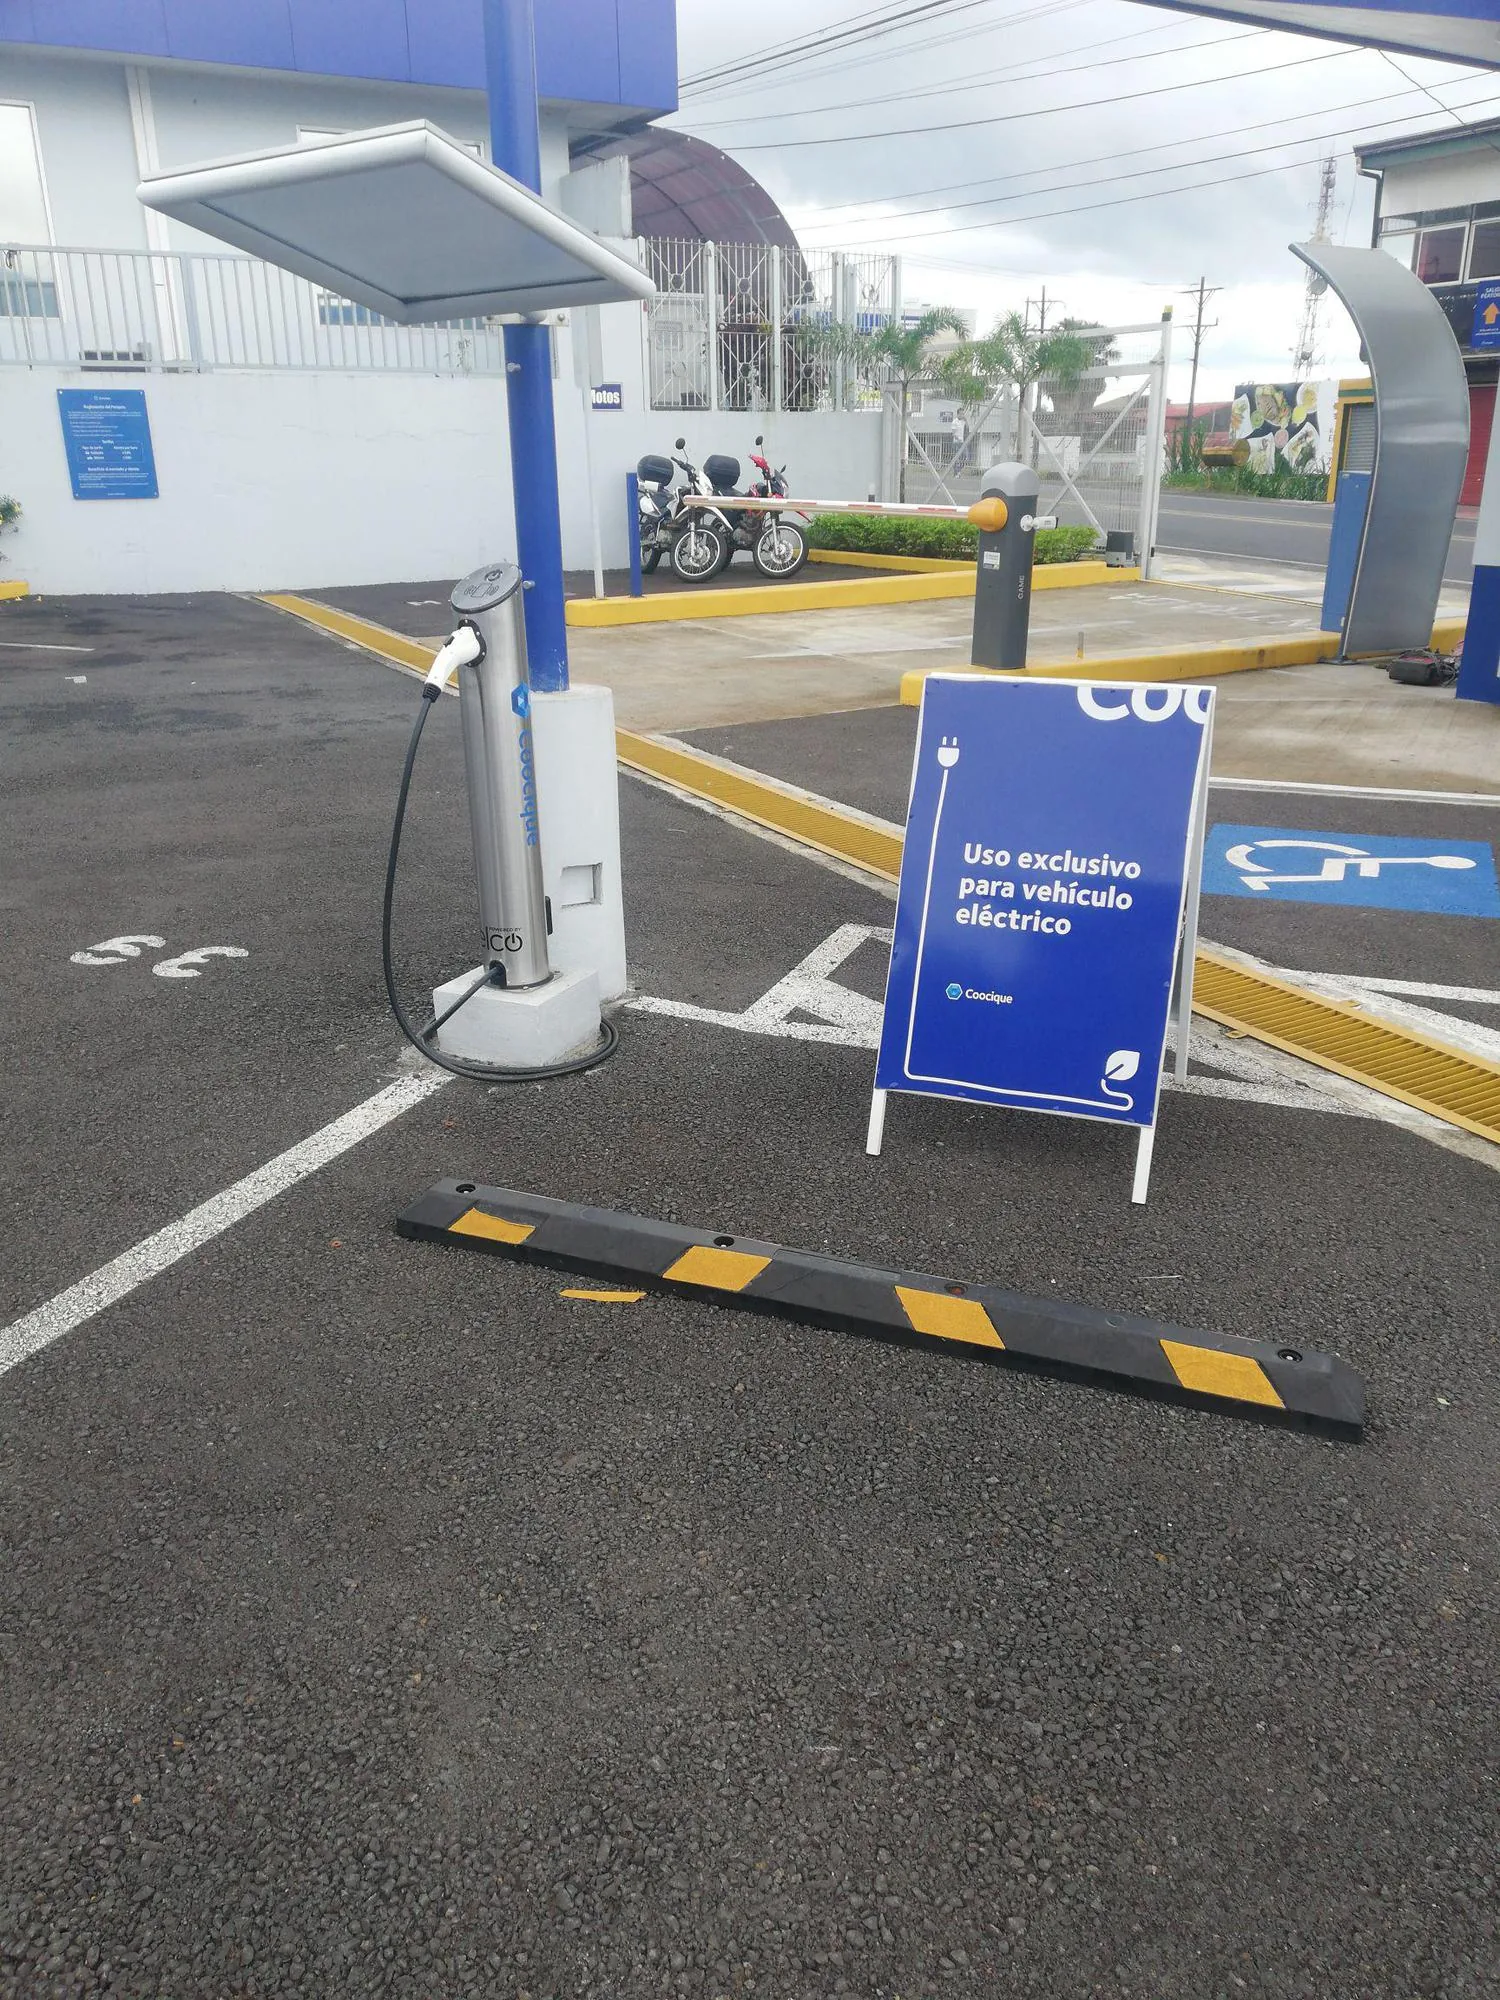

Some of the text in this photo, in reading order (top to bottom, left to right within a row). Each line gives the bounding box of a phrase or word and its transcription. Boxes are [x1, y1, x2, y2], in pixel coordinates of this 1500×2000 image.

[518, 728, 538, 847] Coocique
[963, 843, 1141, 879] Uso exclusivo
[958, 877, 1133, 910] para vehículo
[955, 903, 1072, 935] eléctrico
[965, 988, 1013, 1005] Coocique
